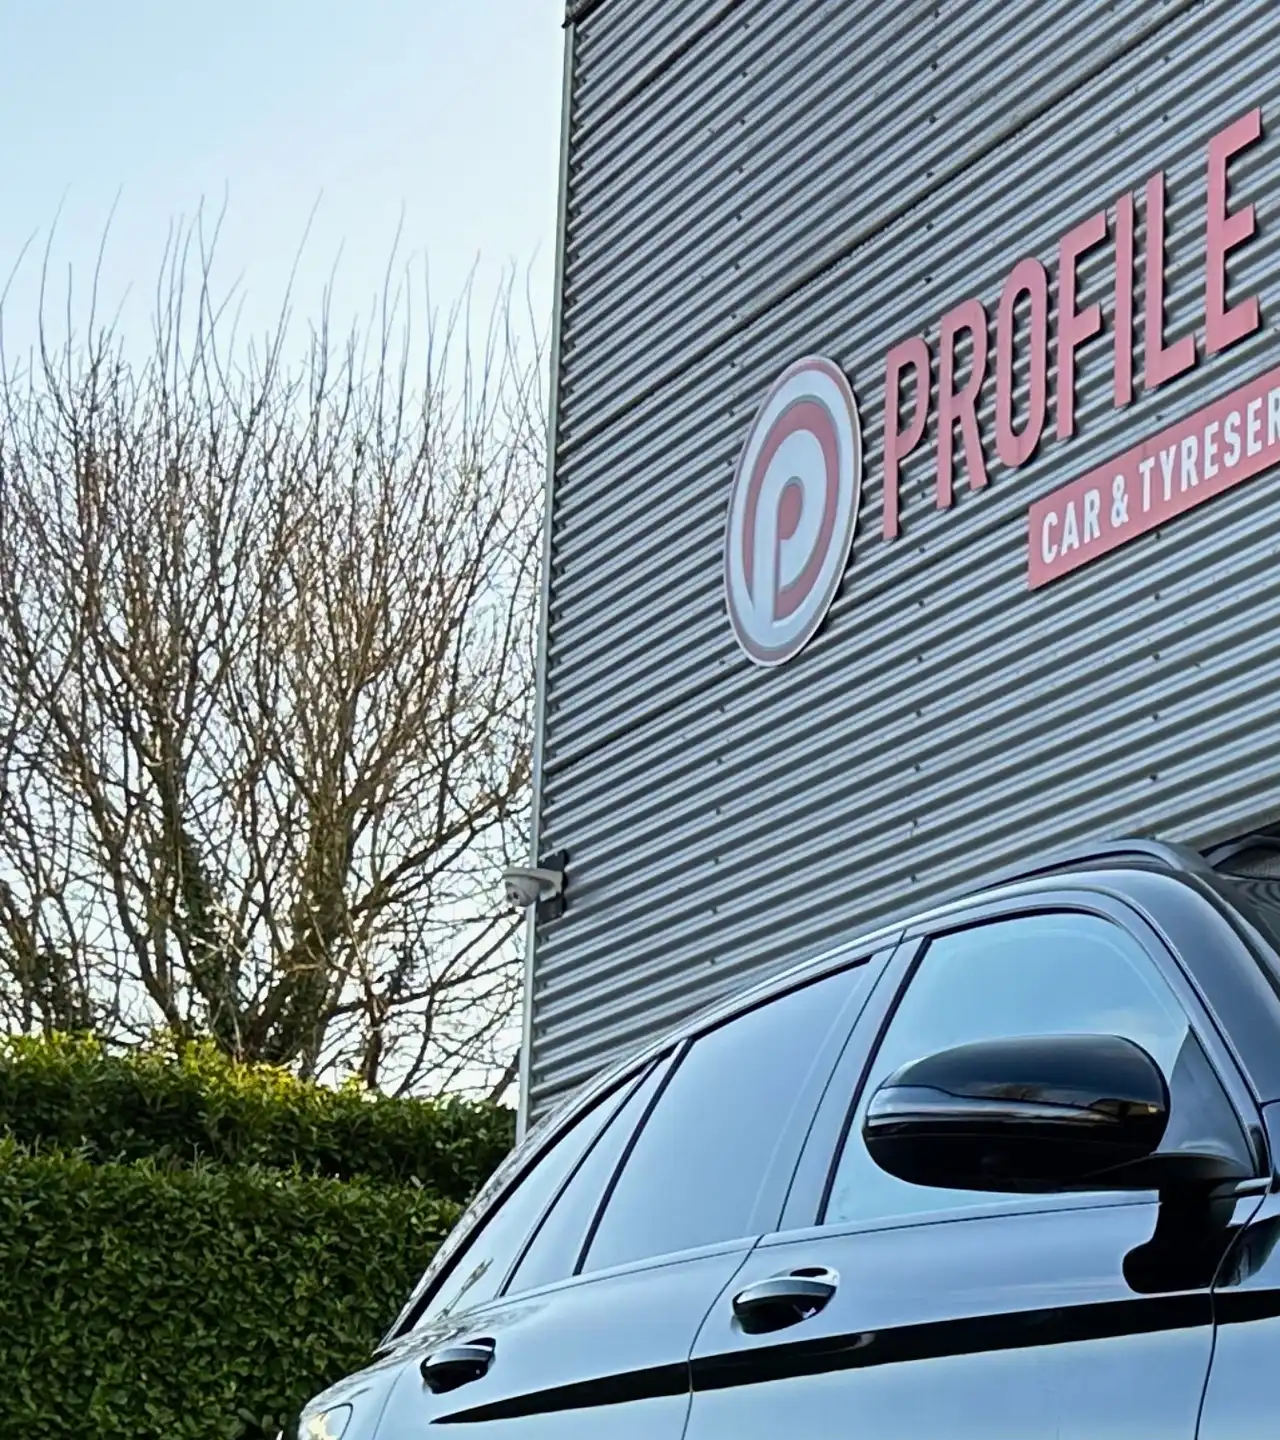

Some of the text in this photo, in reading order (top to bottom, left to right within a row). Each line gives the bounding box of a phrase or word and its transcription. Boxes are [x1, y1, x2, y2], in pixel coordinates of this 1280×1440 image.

[883, 105, 1261, 542] PROFILE
[1042, 489, 1101, 564] CAR
[1110, 474, 1129, 528] &
